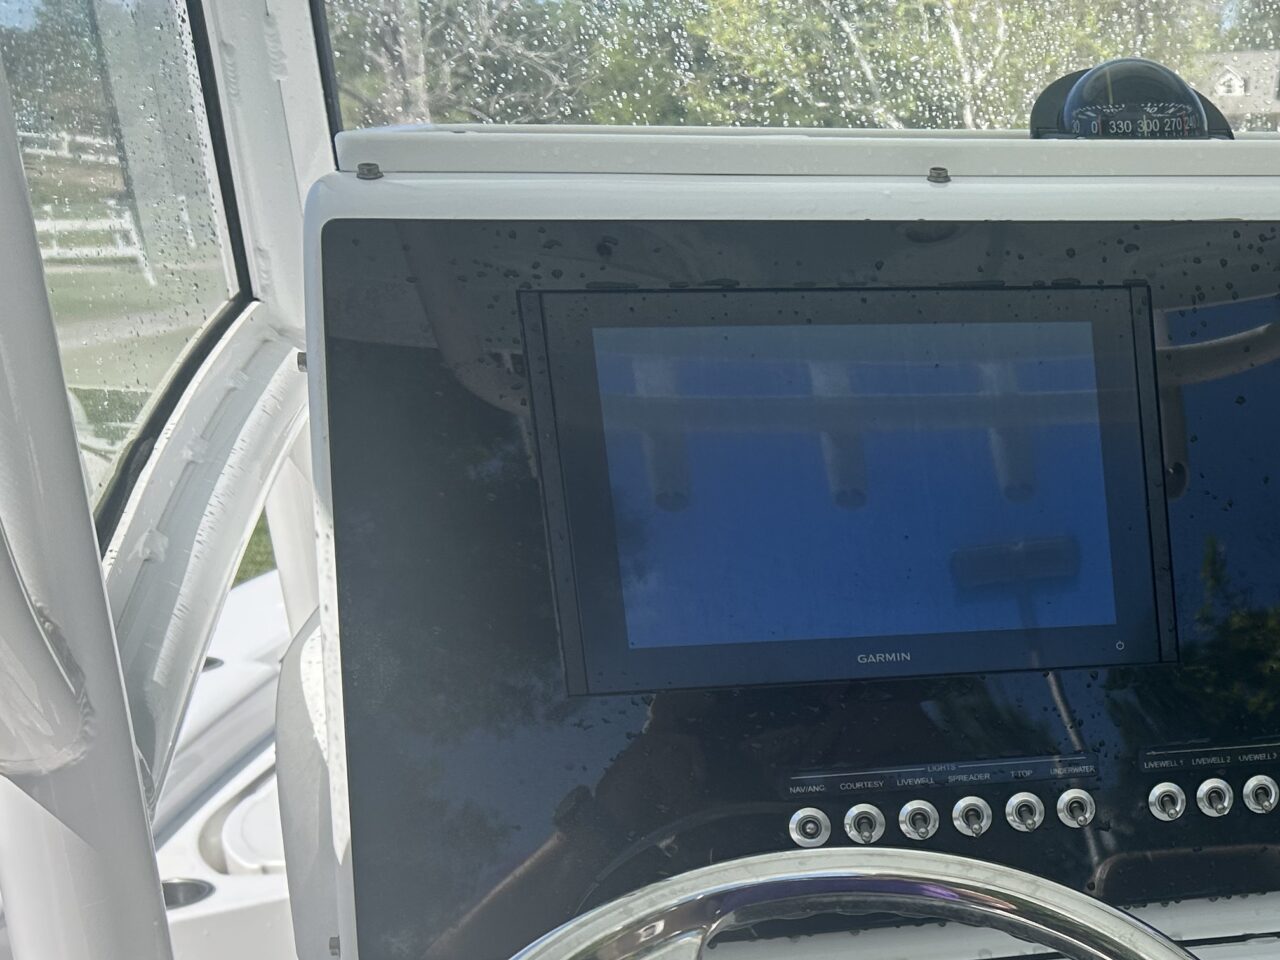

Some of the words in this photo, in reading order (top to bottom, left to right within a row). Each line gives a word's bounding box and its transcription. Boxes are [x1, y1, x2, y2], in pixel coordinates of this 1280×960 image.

[1091, 121, 1098, 133] 0
[1108, 120, 1132, 133] 330
[1137, 119, 1160, 132] 300
[1164, 118, 1182, 131] 270
[857, 651, 911, 664] GARMIN
[1191, 756, 1224, 766] LIVEWELL
[1238, 752, 1271, 762] LIVEWELL
[927, 762, 957, 773] LIGHTS
[1144, 759, 1178, 769] LIVEWELL
[1049, 764, 1096, 776] UNDERWATER
[896, 776, 936, 787] LIVEWELL
[947, 772, 991, 783] SPREADER
[839, 780, 885, 791] COURTESY
